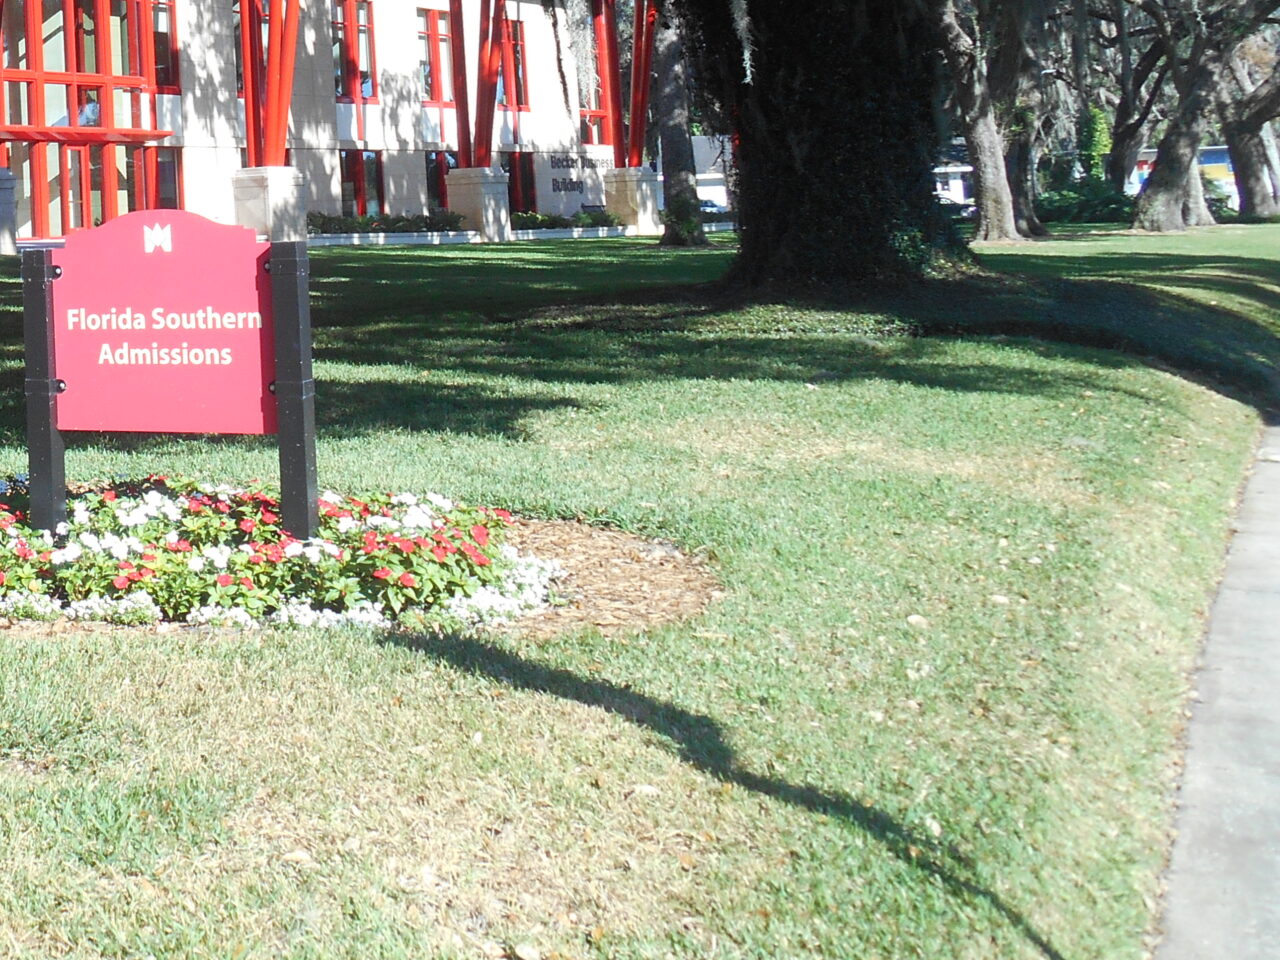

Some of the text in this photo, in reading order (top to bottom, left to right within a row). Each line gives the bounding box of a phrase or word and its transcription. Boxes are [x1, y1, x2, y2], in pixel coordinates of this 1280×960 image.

[551, 155, 614, 169] Becker Business
[552, 178, 583, 194] Building
[67, 306, 262, 330] Florida Southern
[98, 342, 233, 365] Admissions
